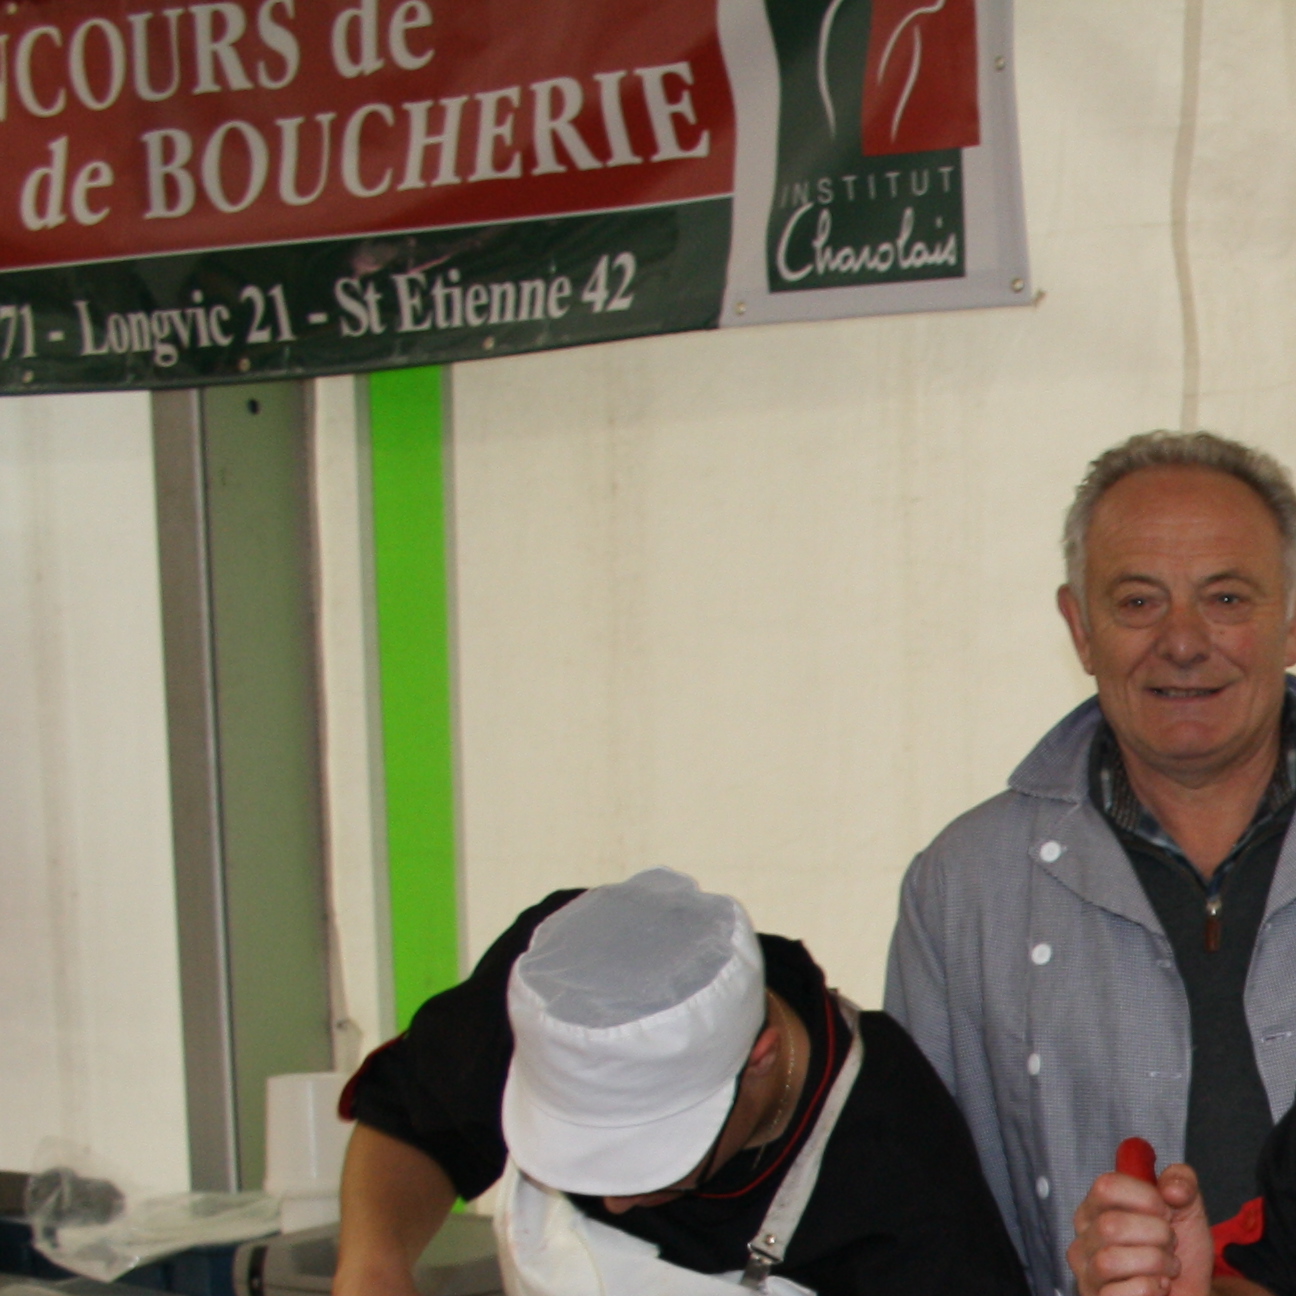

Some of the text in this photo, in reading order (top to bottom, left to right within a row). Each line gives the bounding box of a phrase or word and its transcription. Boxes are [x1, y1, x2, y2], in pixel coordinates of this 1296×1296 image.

[0, 0, 435, 122] COURS de
[20, 61, 711, 231] de BOUCHERIE
[779, 166, 955, 209] INSTITUT
[776, 201, 957, 283] Charolais
[0, 304, 37, 361] 71
[75, 289, 233, 368] Longvic
[240, 283, 297, 342] 21
[335, 276, 386, 337] St
[393, 267, 573, 333] Etienne
[582, 251, 637, 314] 42
